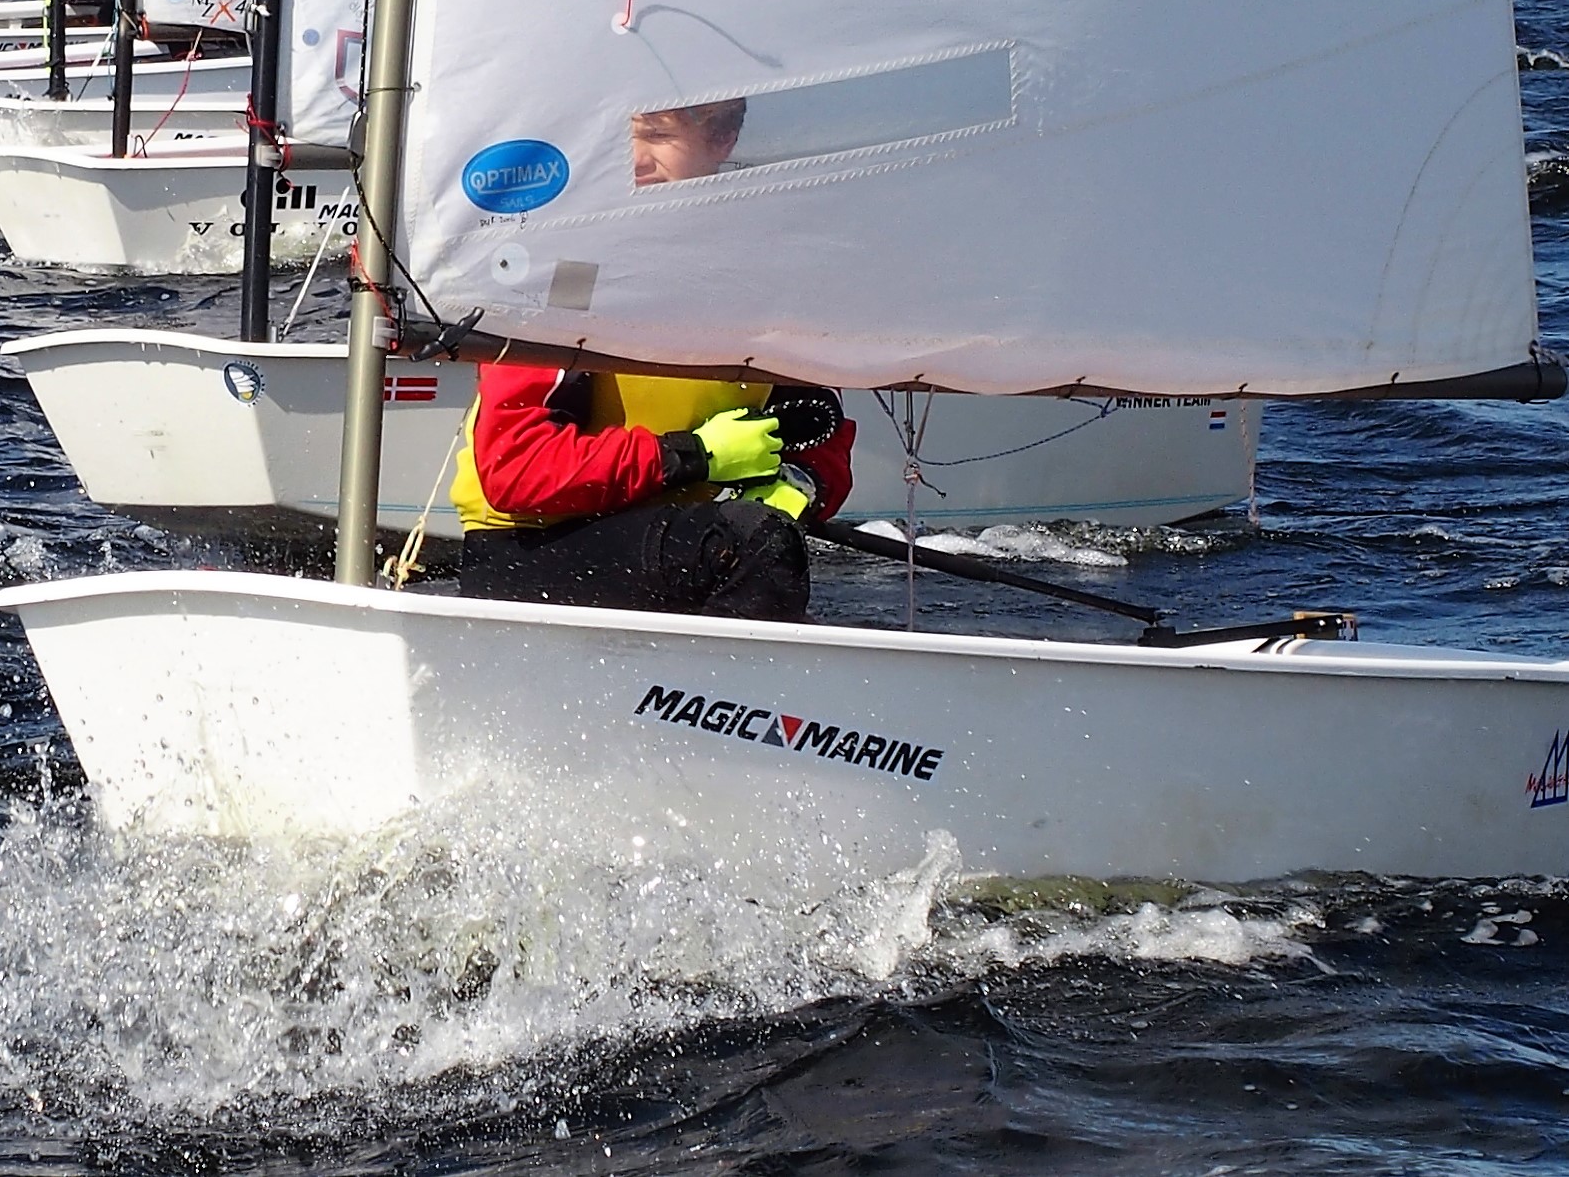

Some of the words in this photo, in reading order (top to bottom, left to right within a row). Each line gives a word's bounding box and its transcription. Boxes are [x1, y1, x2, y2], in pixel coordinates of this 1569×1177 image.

[471, 160, 561, 194] OPTIMAX
[240, 178, 317, 210] ill
[189, 222, 358, 236] VOLO
[634, 685, 772, 741] MAGIC
[794, 721, 945, 781] MARINE
